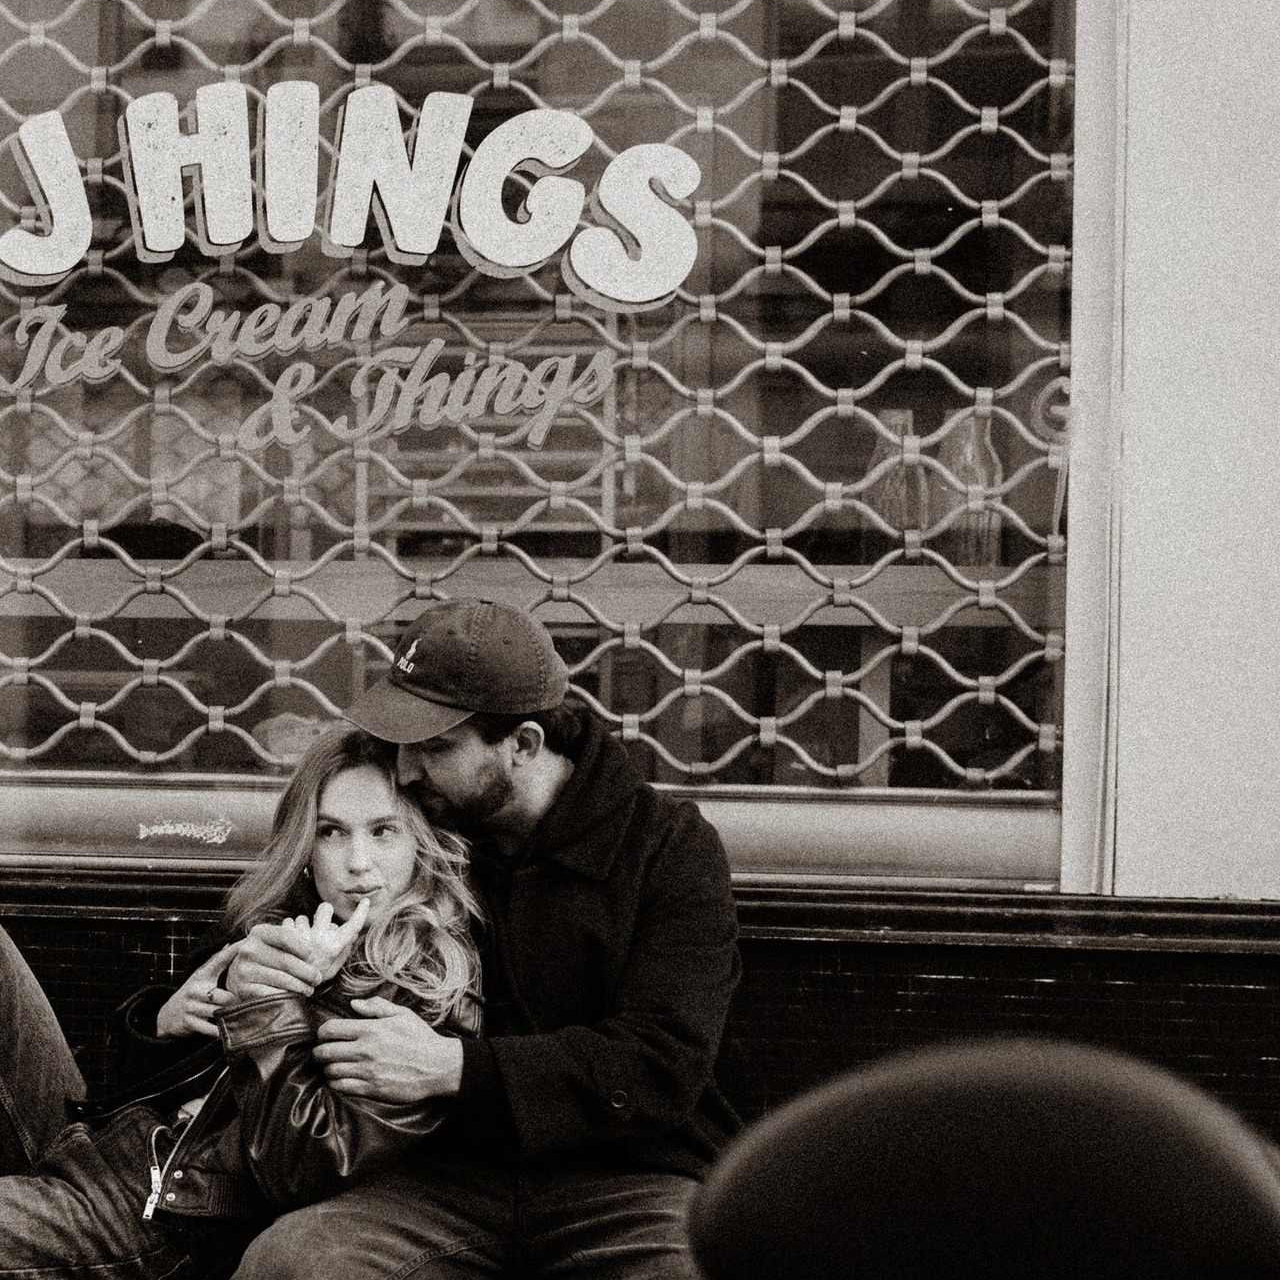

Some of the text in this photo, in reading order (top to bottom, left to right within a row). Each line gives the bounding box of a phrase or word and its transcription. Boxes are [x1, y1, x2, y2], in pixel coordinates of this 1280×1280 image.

[120, 80, 702, 313] HINGS
[146, 281, 410, 373] Cream
[236, 337, 618, 451] & Things
